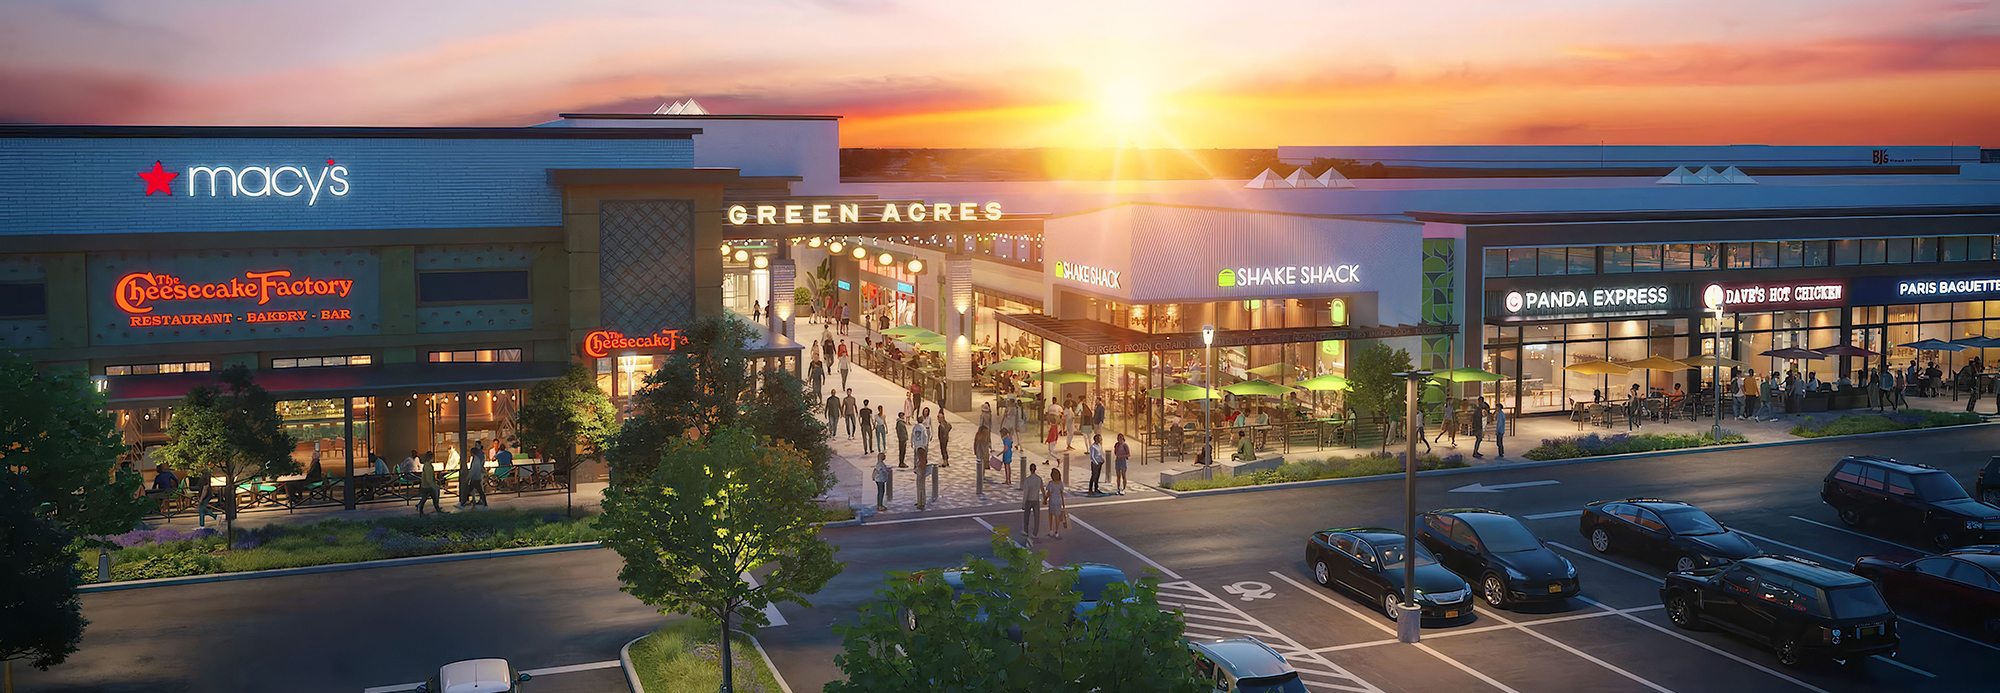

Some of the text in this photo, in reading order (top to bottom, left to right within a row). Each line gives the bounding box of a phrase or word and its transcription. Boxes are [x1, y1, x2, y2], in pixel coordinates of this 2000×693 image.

[1873, 149, 1889, 165] BJ's
[189, 159, 350, 206] macy's
[728, 201, 1003, 225] GREEN ACRES
[156, 274, 180, 286] The
[1063, 262, 1122, 290] SHAKE SHACK
[1237, 264, 1361, 286] SHAKE SHACK
[115, 270, 353, 313] Cheesecake Factory
[1526, 287, 1668, 309] PANDA EXPRESS
[1725, 285, 1843, 304] DAVE'S HOT CHICKEN
[1899, 282, 1938, 296] PARIS
[129, 314, 233, 327] RESTAURANT
[246, 311, 308, 323] BAKERY
[320, 310, 351, 320] BAR
[585, 330, 670, 358] Cheesecake
[609, 331, 624, 340] The
[1125, 343, 1151, 352] FROZEN
